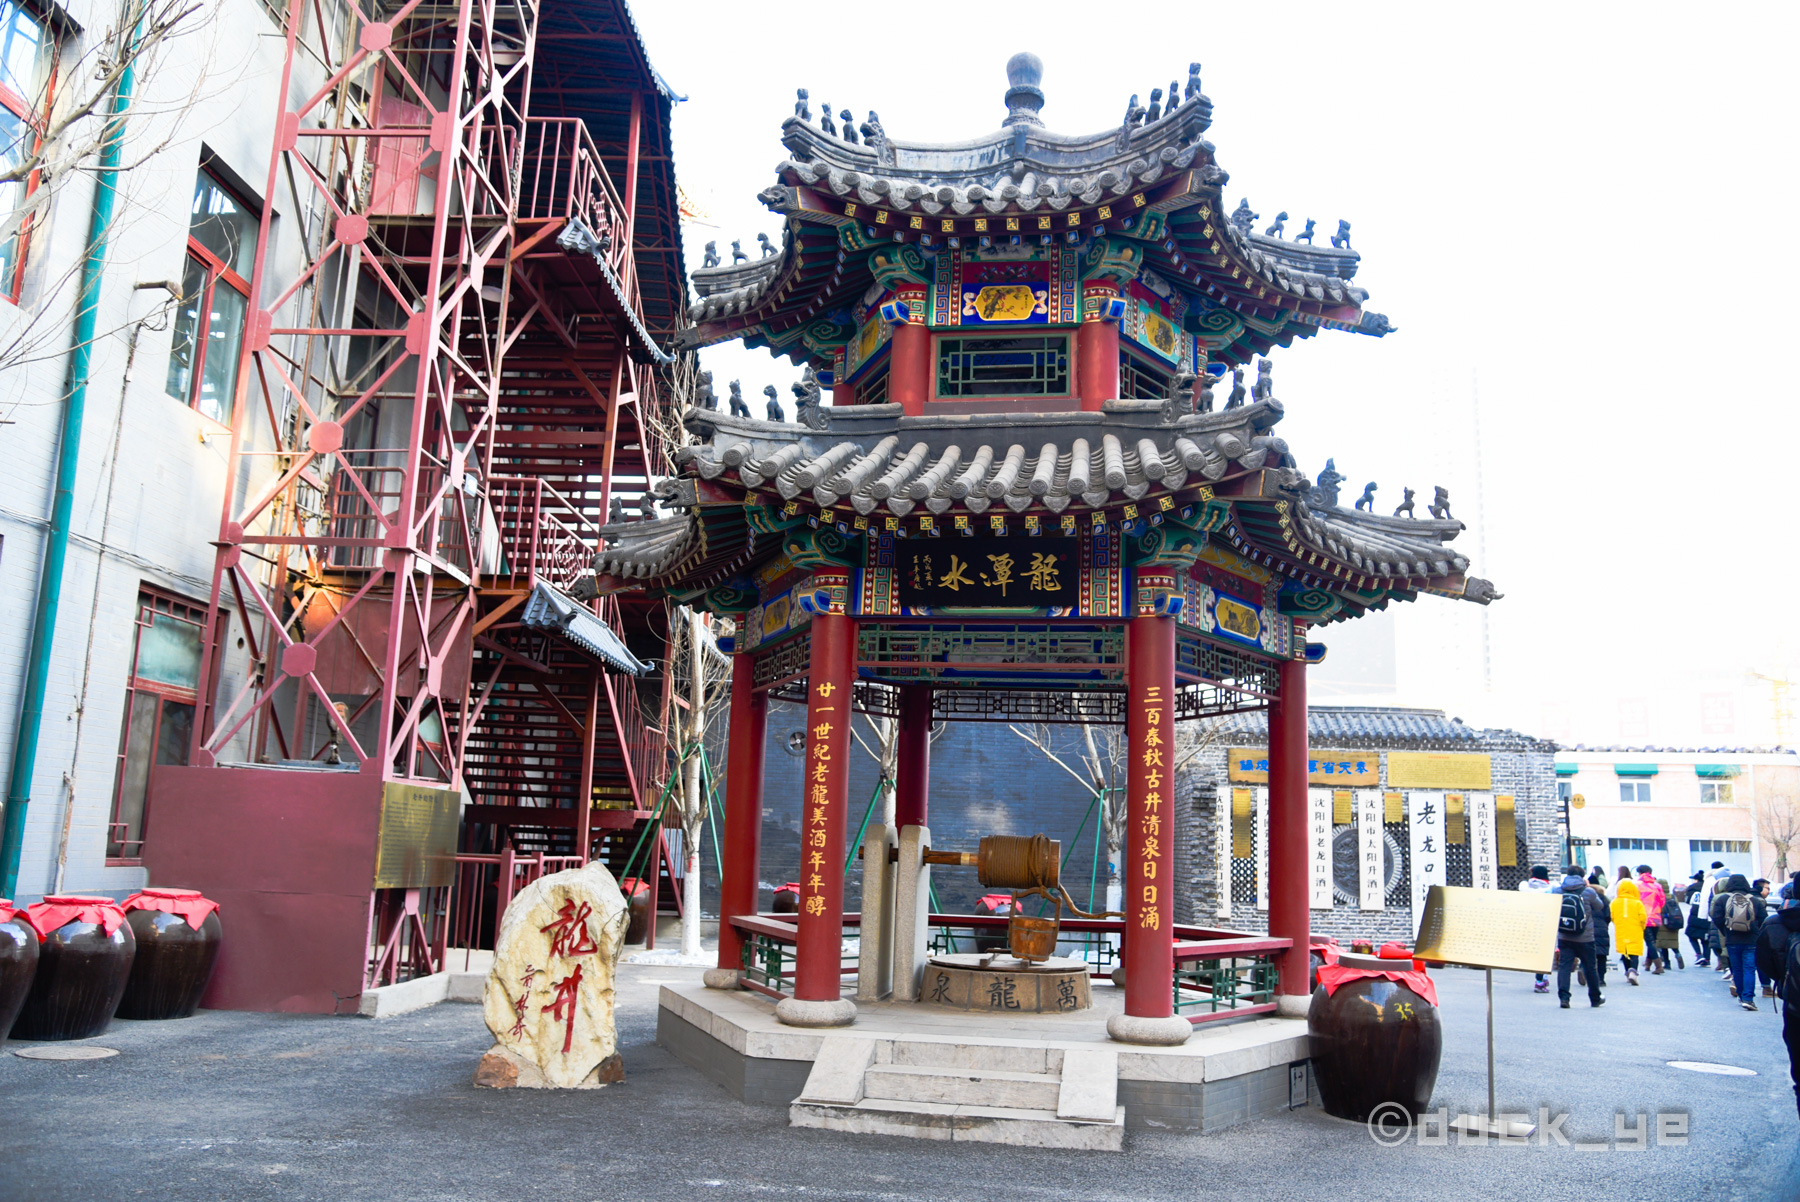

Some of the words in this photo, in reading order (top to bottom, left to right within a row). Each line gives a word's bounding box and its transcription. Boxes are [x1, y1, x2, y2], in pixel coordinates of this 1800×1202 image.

[805, 681, 836, 918] 廿一世紀老龍美酒年年醇
[1139, 686, 1165, 931] 三百春秋古井清泉日日涌
[1314, 798, 1327, 900] 沈阳市老龙口酒厂
[1365, 799, 1378, 901] 沈阳市太阳升酒厂
[1416, 801, 1437, 902] 老龙口
